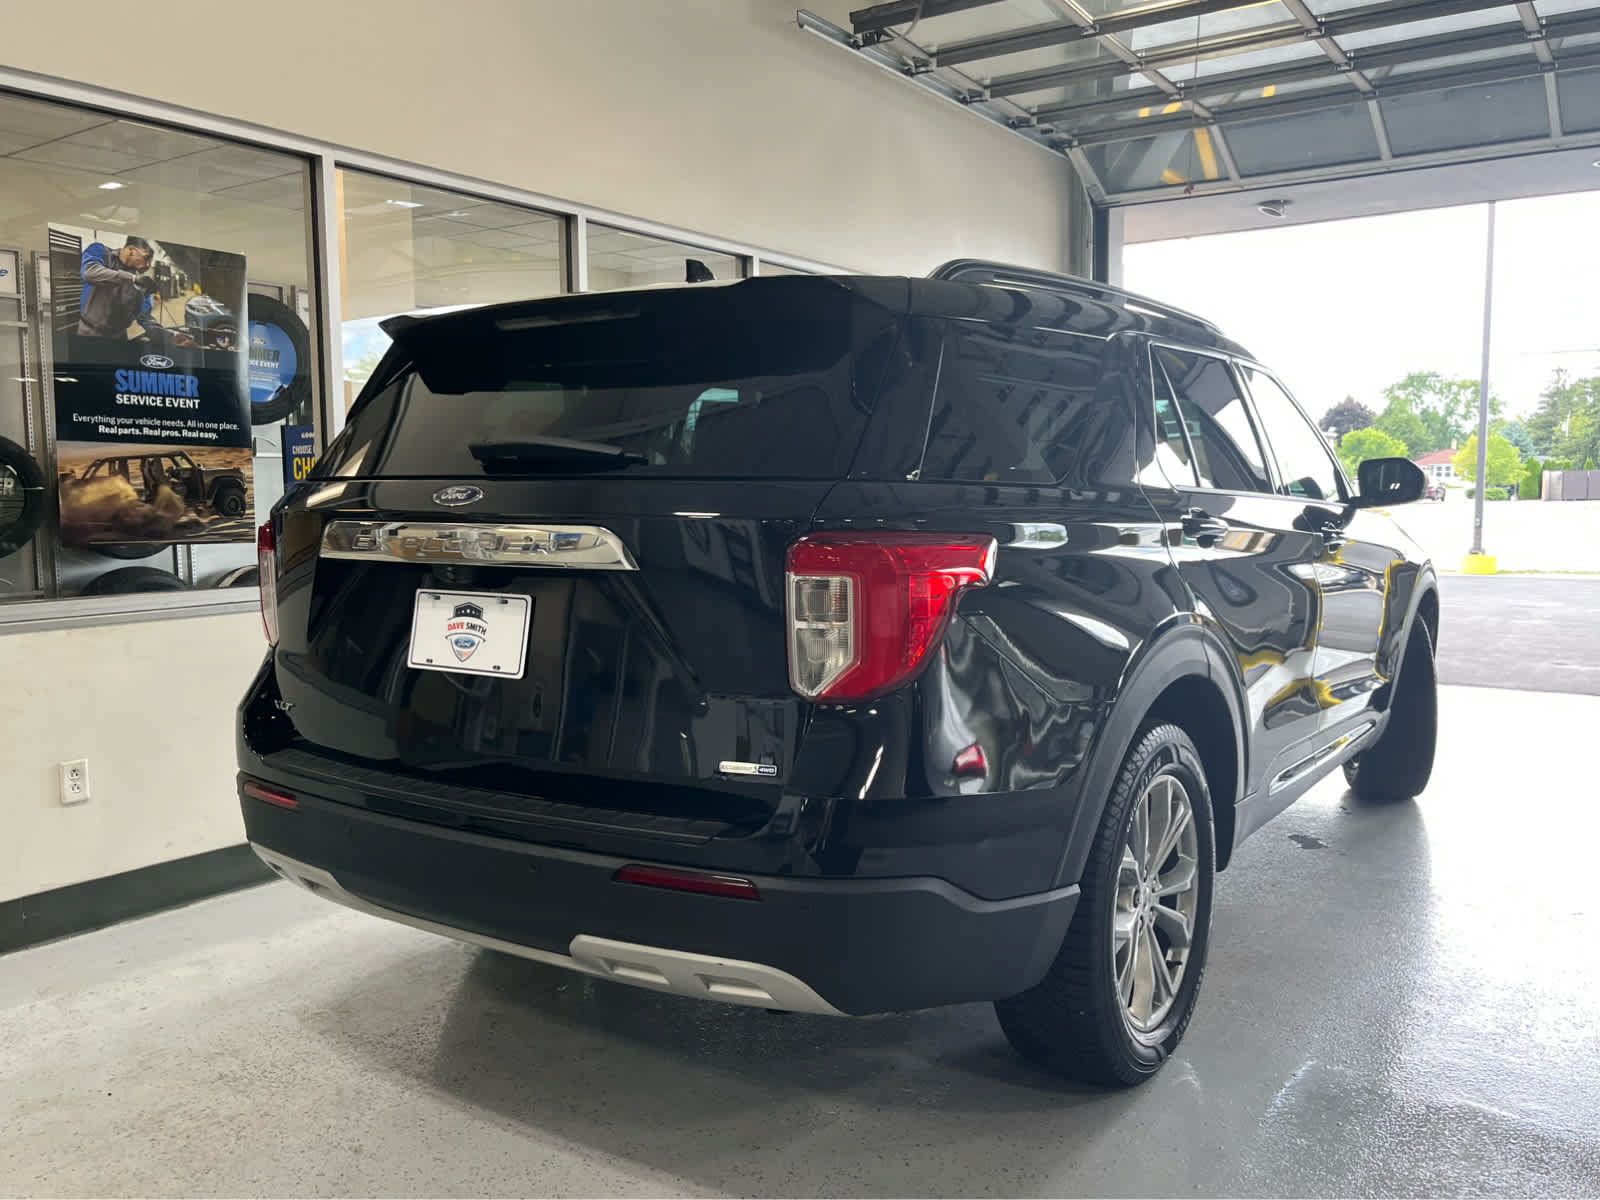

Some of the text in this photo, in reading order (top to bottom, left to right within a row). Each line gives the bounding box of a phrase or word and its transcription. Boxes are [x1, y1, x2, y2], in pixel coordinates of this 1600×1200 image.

[114, 368, 200, 398] SUMMER
[115, 393, 200, 409] SERVICE EVENT
[72, 413, 240, 431] Everything your vehicle needs. All in one place.
[98, 425, 219, 440] Real parts. Real pros. Real easy.
[437, 486, 477, 502] Ford
[447, 621, 488, 636] DAVE SMITH
